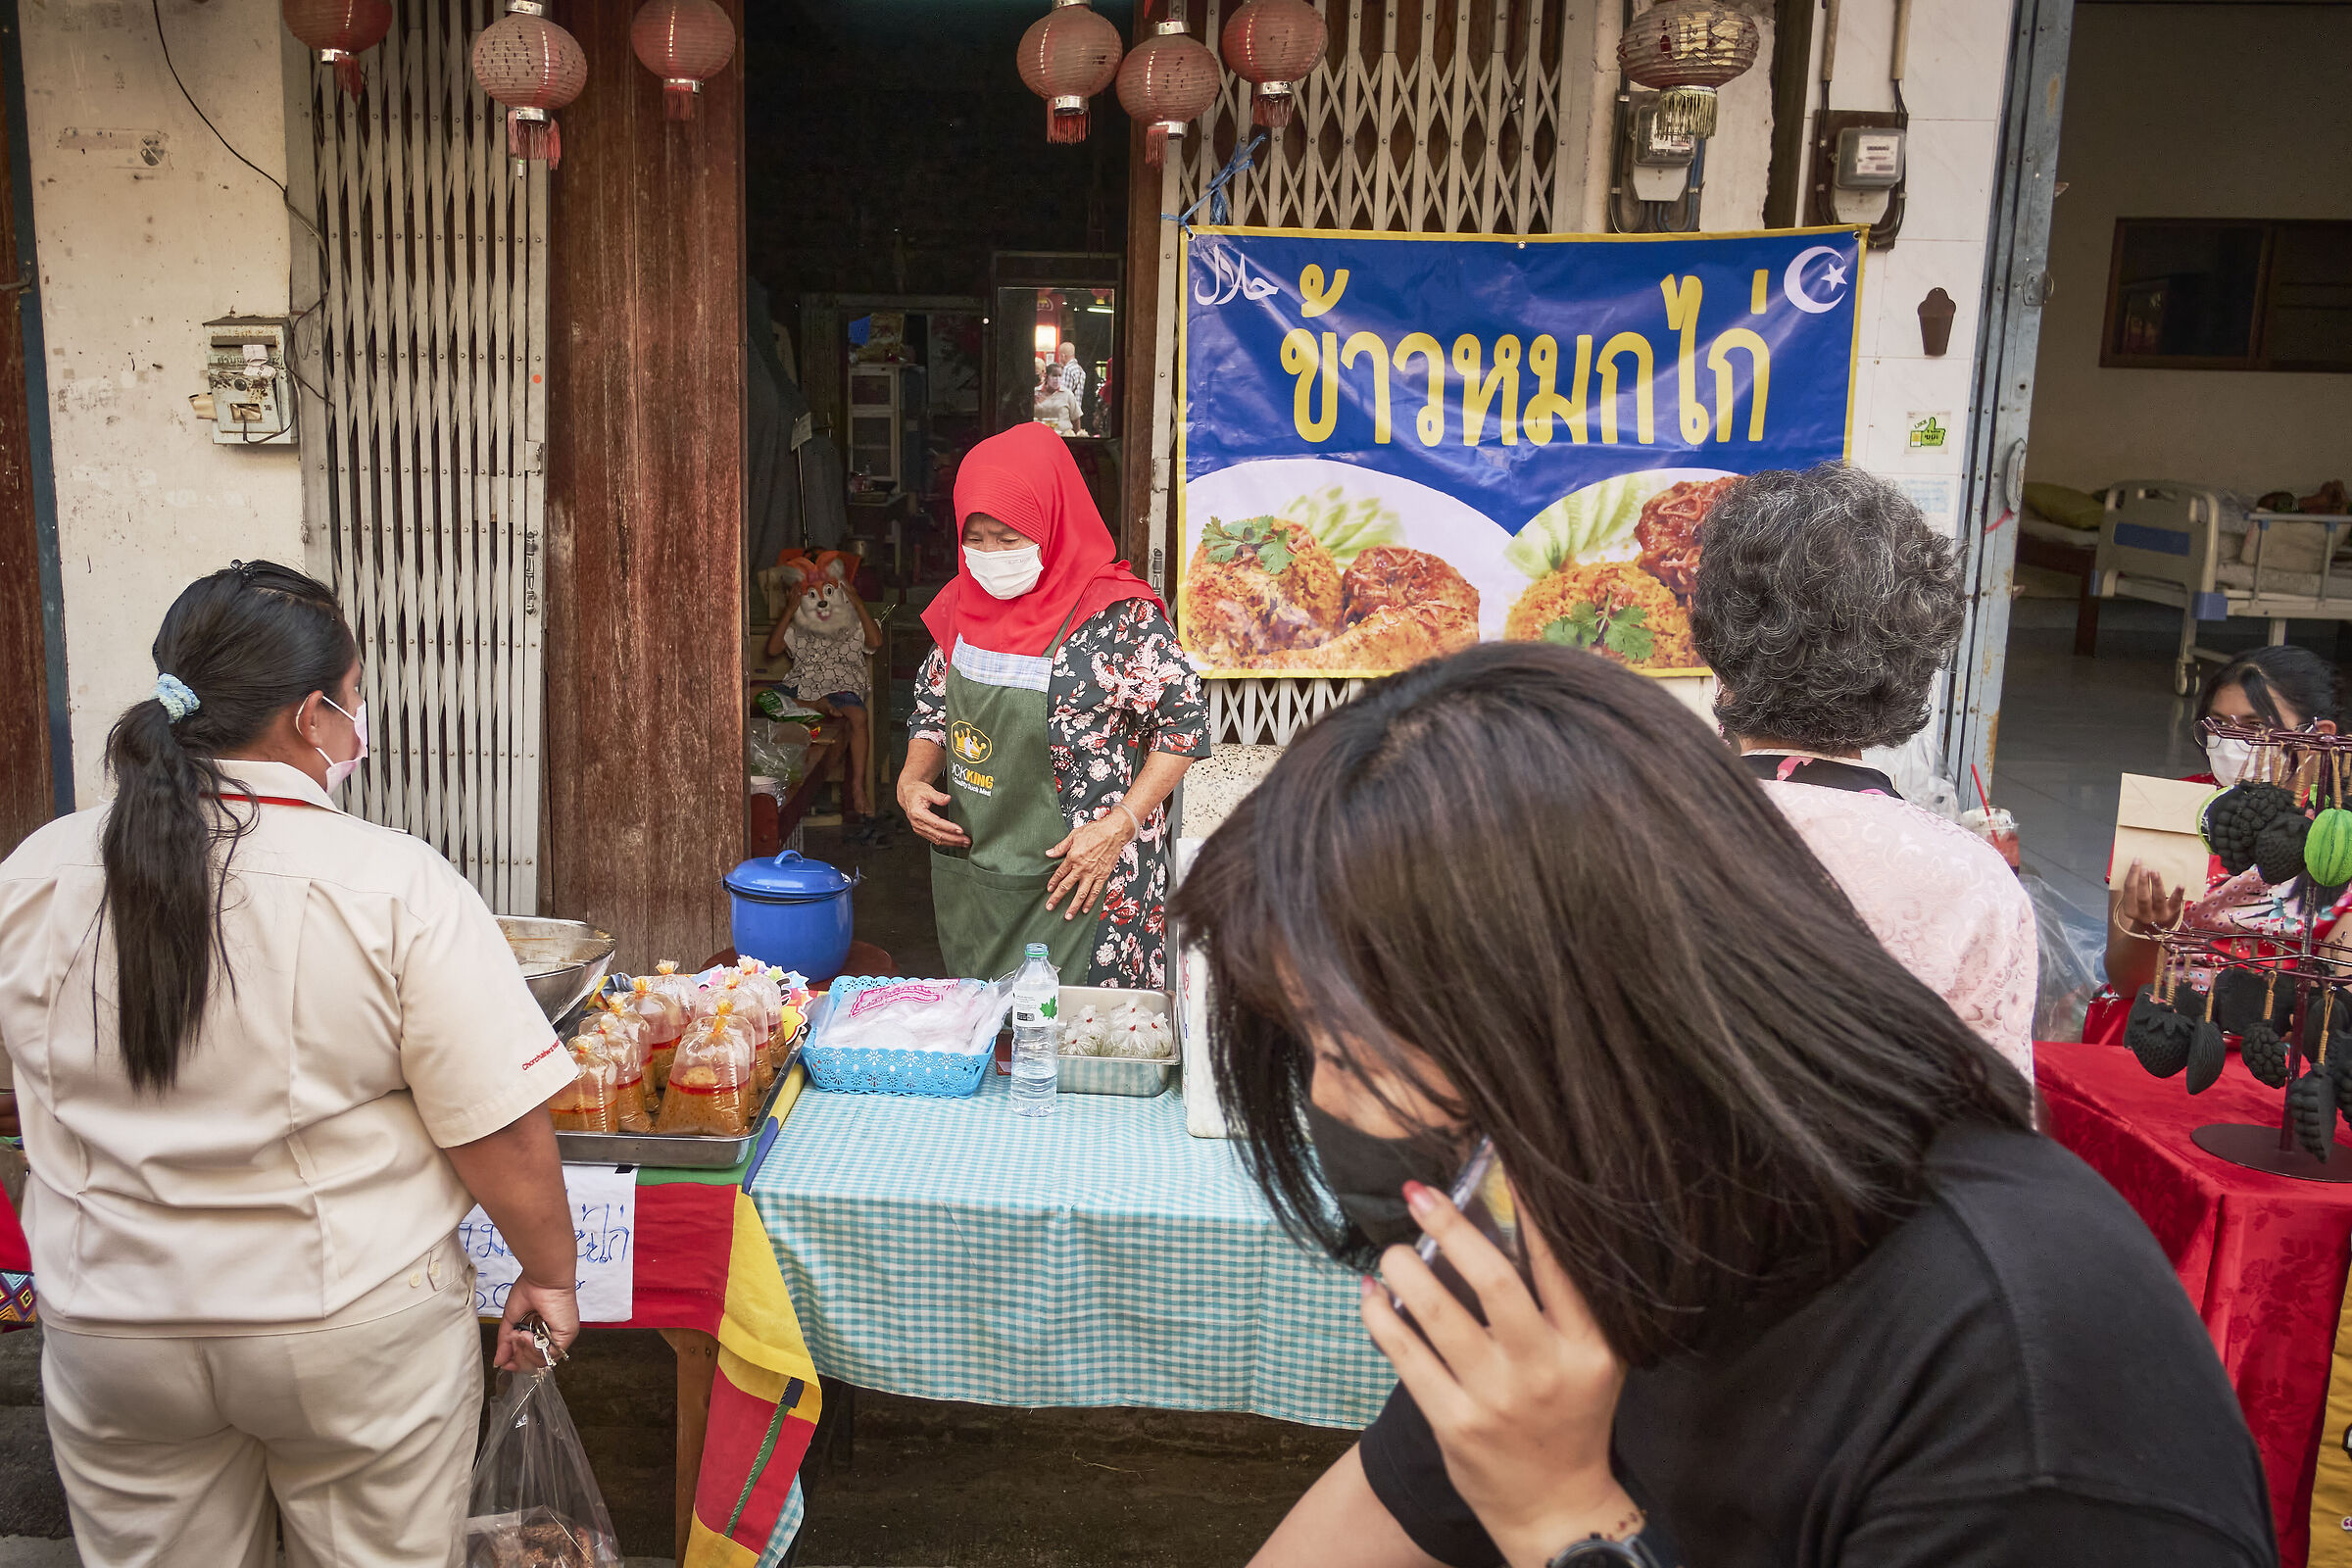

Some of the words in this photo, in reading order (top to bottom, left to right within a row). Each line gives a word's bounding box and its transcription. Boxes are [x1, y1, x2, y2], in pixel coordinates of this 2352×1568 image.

[1194, 244, 1280, 306] حلال
[1280, 262, 1772, 447] ข้าวหมกไก่
